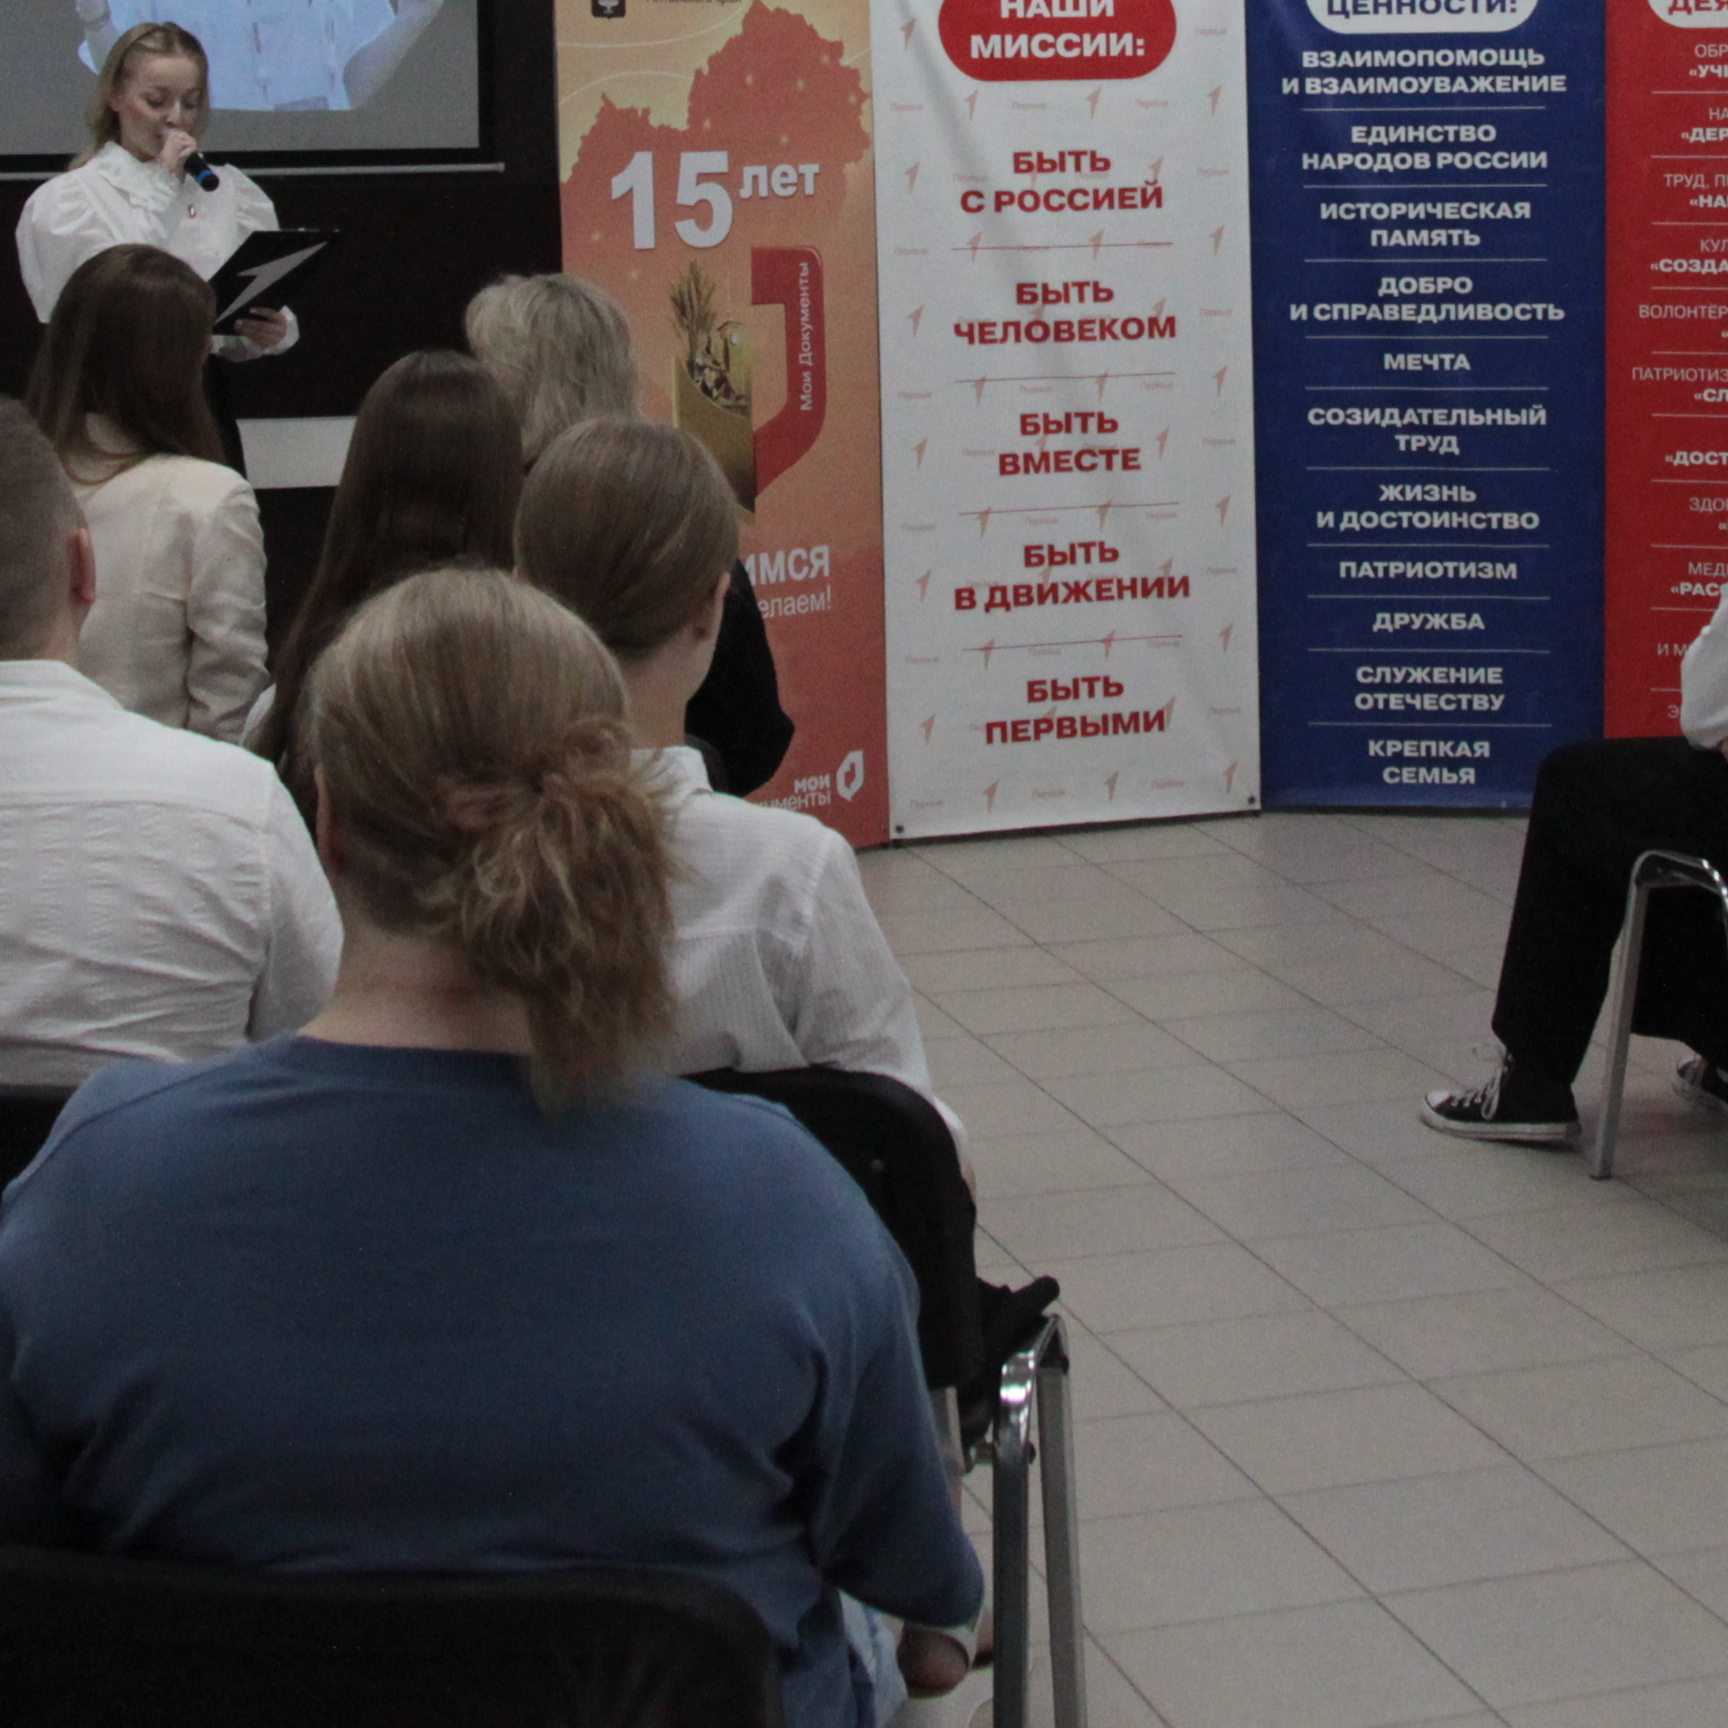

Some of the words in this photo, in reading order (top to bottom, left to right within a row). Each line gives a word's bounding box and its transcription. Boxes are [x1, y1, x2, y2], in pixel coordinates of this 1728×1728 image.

[970, 33, 1145, 59] МИССИИ:
[1302, 48, 1545, 69] ВЗАИМОПОМОЩЬ
[1282, 78, 1300, 95] И
[1305, 75, 1567, 95] ВЗАИМОУВАЖЕНИЕ
[1351, 125, 1496, 146] ЕДИНСТВО
[1012, 150, 1111, 174] БЫТЬ
[1302, 152, 1431, 173] НАРОДОВ
[1437, 151, 1548, 169] РОССИИ
[1664, 174, 1709, 190] ТРУД,
[611, 150, 733, 250] 15
[739, 163, 820, 199] лет
[960, 189, 985, 214] С
[994, 180, 1164, 213] РОССИЕЙ
[1320, 202, 1531, 220] ИСТОРИЧЕСКАЯ
[1371, 229, 1481, 247] ПАМЯТЬ
[1015, 281, 1114, 305] БЫТЬ
[1378, 276, 1473, 296] ДОБРО
[800, 261, 814, 365] Документы
[1290, 304, 1307, 321] И
[1314, 303, 1565, 323] СПРАВЕДЛИВОСТЬ
[954, 316, 1176, 345] ЧЕЛОВЕКОМ
[1383, 353, 1471, 371] МЕЧТА
[800, 378, 814, 411] Мои
[1019, 411, 1119, 436] БЫТЬ
[1307, 403, 1547, 428] СОЗИДАТЕЛЬНЫЙ
[1395, 434, 1460, 455] ТРУД
[998, 448, 1141, 476] ВМЕСТЕ
[1379, 484, 1477, 502] ЖИЗНЬ
[1317, 511, 1335, 528] И
[1340, 511, 1540, 532] ДОСТОИНСТВО
[1023, 541, 1119, 568] БЫТЬ
[745, 544, 830, 587] ИМСЯ
[1339, 561, 1518, 580] ПАТРИОТИЗМ
[757, 585, 832, 620] елаем!
[954, 588, 976, 611] В
[985, 576, 1190, 613] ДВИЖЕНИИ
[1373, 612, 1485, 633] ДРУЖБА
[1657, 642, 1669, 656] И
[1356, 666, 1503, 685] СЛУЖЕНИЕ
[1026, 675, 1124, 703] БЫТЬ
[1354, 693, 1505, 711] ОТЕЧЕСТВУ
[985, 710, 1165, 744] ПЕРВЫМИ
[1368, 739, 1490, 758] КРЕПКАЯ
[1382, 767, 1476, 785] СЕМЬЯ
